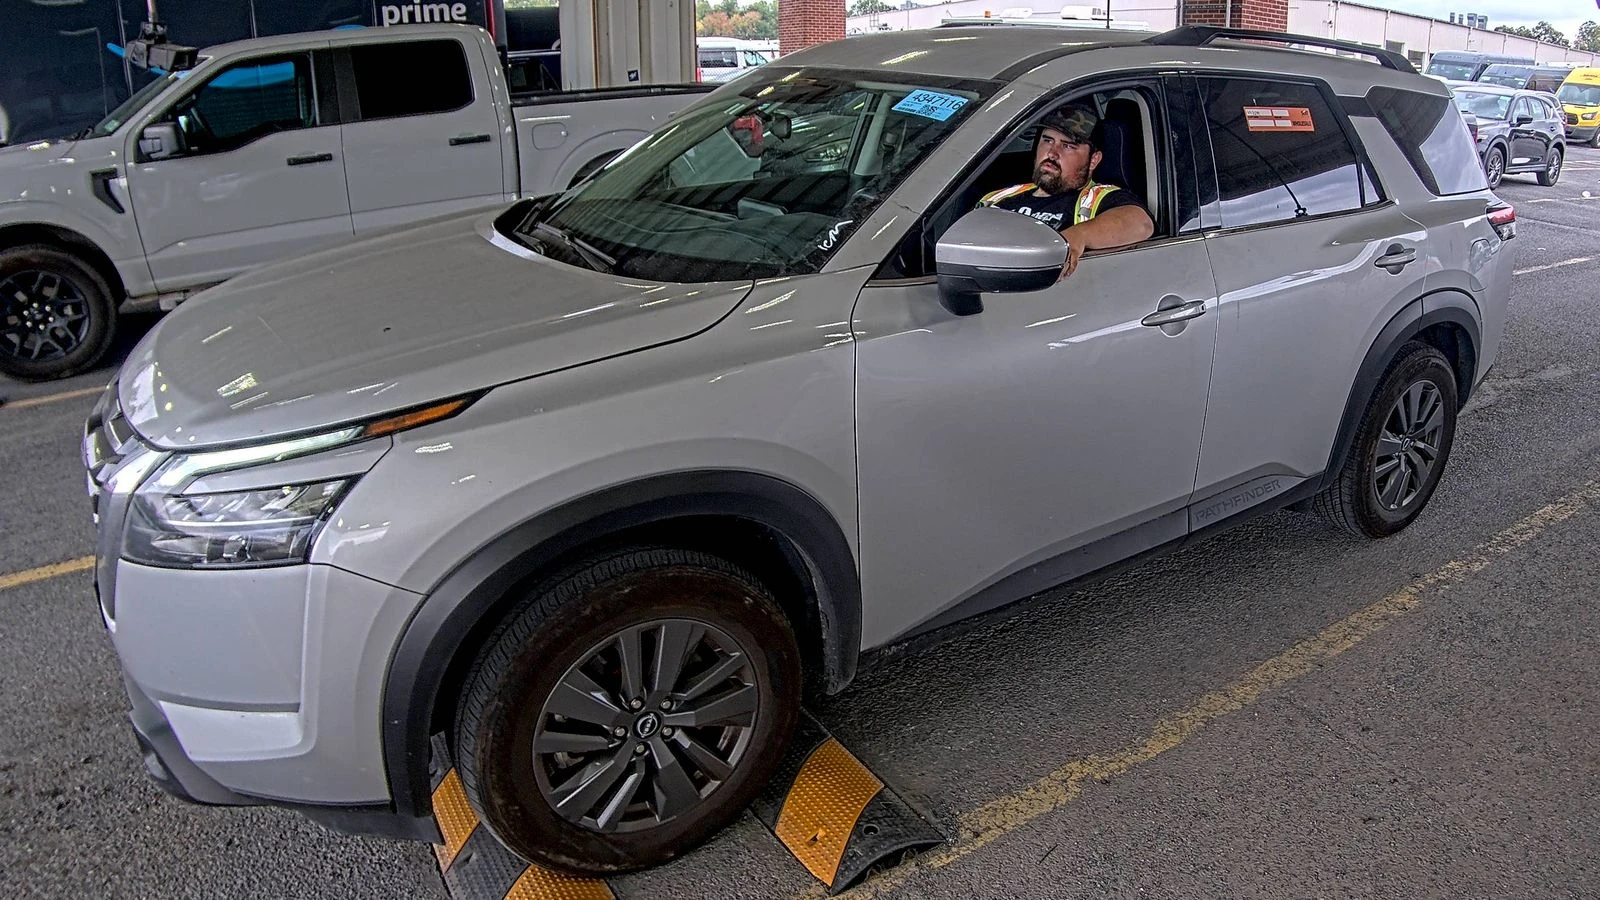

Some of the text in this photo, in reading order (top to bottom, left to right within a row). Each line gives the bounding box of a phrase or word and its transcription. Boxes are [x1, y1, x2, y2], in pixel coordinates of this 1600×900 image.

[381, 0, 467, 28] prime
[912, 93, 965, 110] 4347116
[1194, 479, 1281, 520] PATHFINDER
